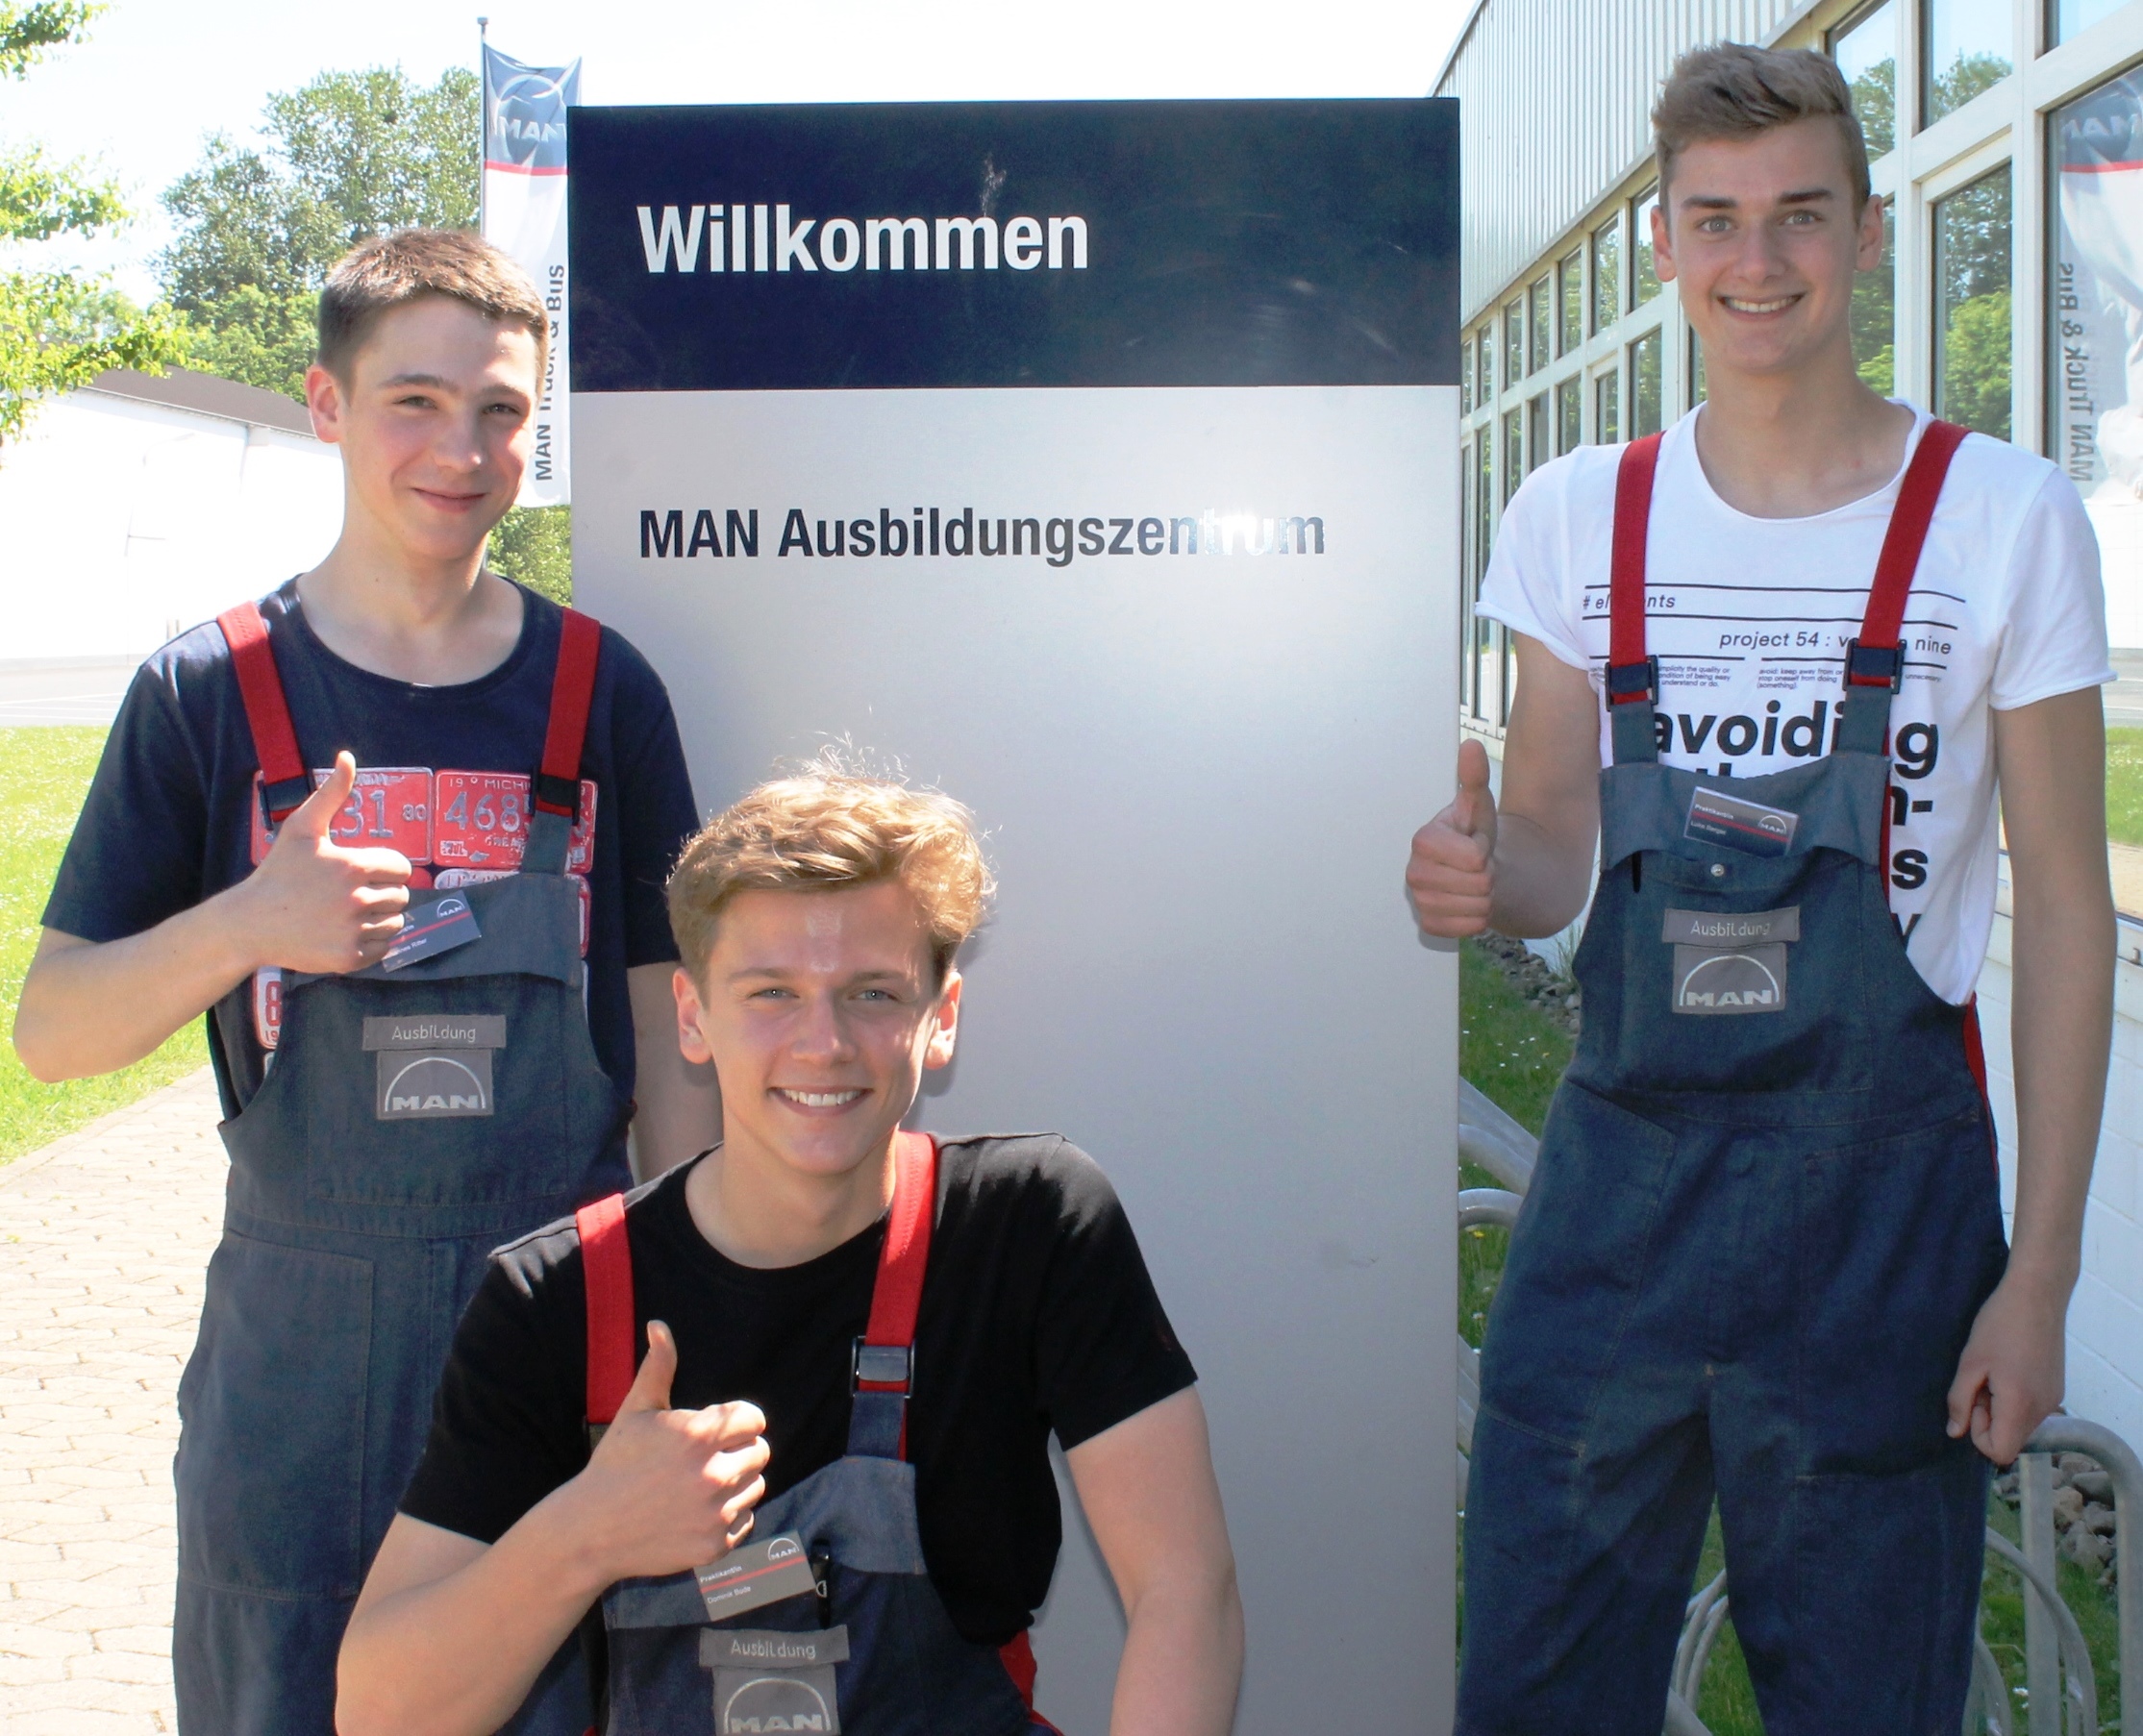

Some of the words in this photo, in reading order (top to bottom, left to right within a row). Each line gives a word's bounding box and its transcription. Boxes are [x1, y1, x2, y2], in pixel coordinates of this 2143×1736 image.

[498, 116, 567, 143] MAN
[636, 204, 1088, 273] Willkommen
[535, 424, 553, 481] MAN
[546, 264, 565, 311] Bus
[639, 509, 760, 558] MAN
[778, 507, 1326, 568] Ausbildungszentrum
[1595, 593, 1676, 610] elnts
[1719, 631, 1790, 650] project
[1795, 631, 1820, 648] 54
[1915, 634, 1952, 655] nine
[485, 779, 531, 791] MICHI
[439, 905, 463, 917] MAN
[1689, 919, 1772, 937] Ausbildung
[1685, 989, 1773, 1007] MAN
[392, 1025, 477, 1043] Ausbildung
[392, 1094, 479, 1110] MAN
[731, 1639, 817, 1659] Ausbildung
[730, 1713, 824, 1735] MAN
